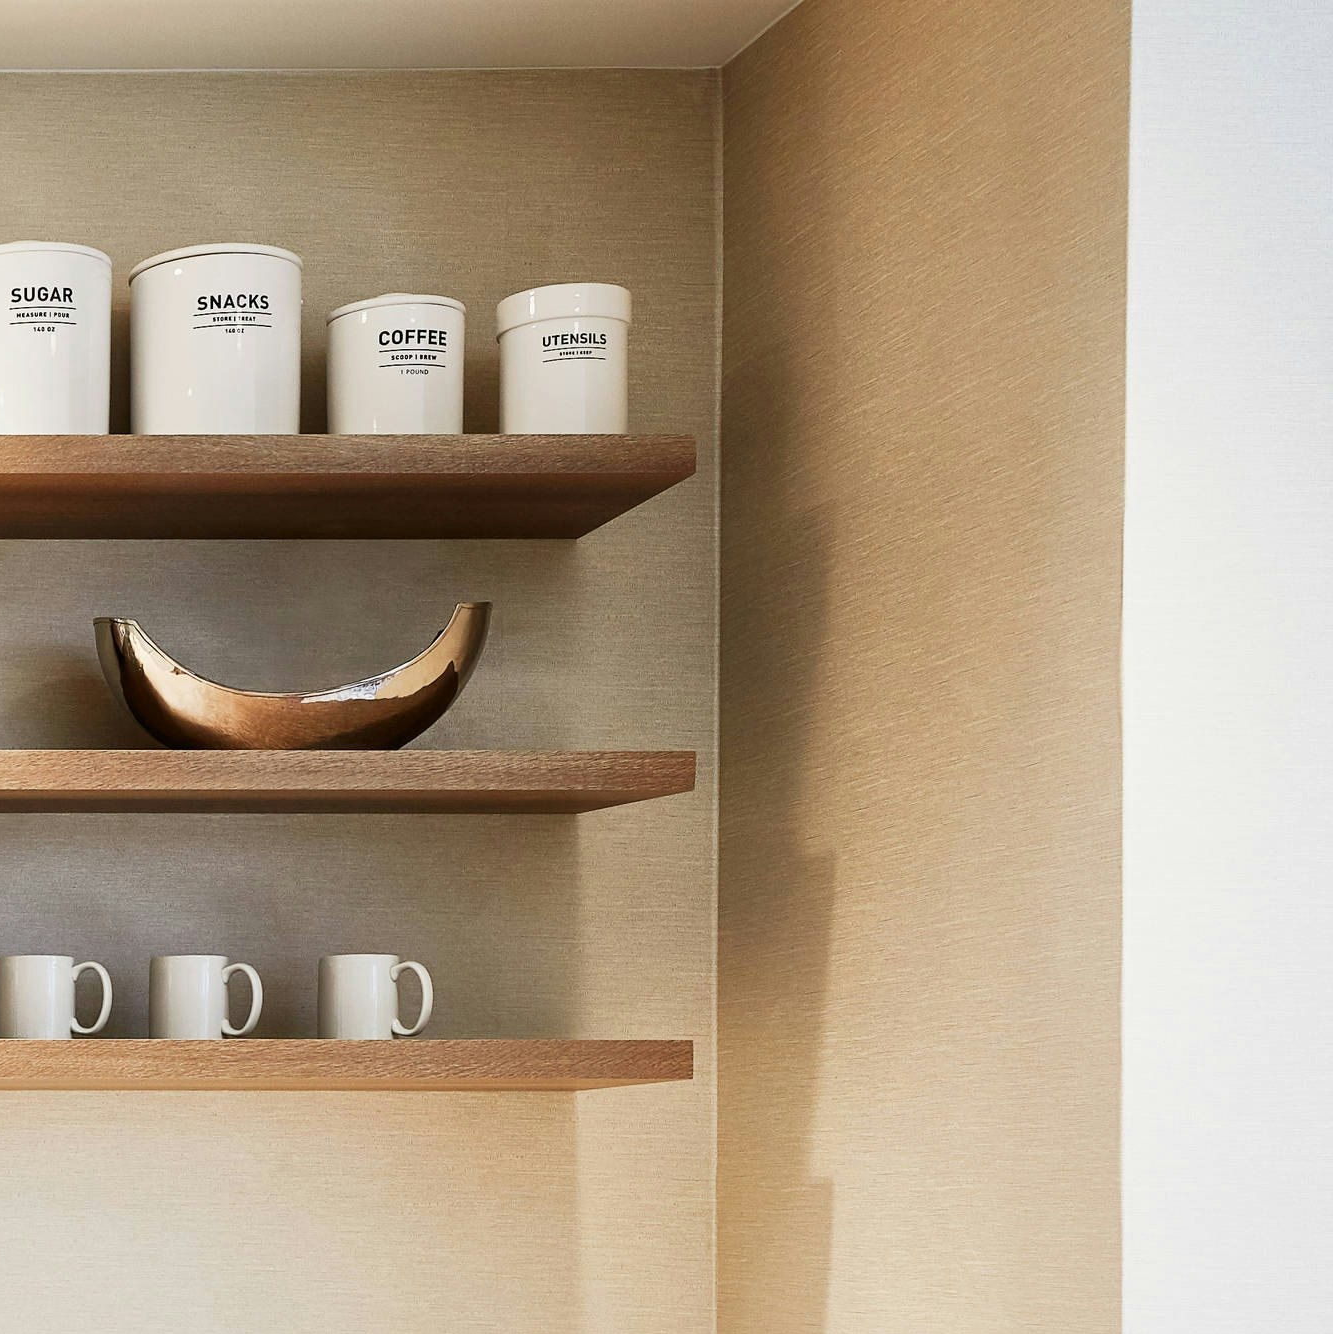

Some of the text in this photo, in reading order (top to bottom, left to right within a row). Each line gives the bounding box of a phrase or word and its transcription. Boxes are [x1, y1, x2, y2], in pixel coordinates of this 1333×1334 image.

[10, 286, 74, 303] SUGAR
[197, 293, 270, 311] SNACKS
[378, 329, 447, 347] COFFEE
[542, 332, 607, 347] UTENSILS
